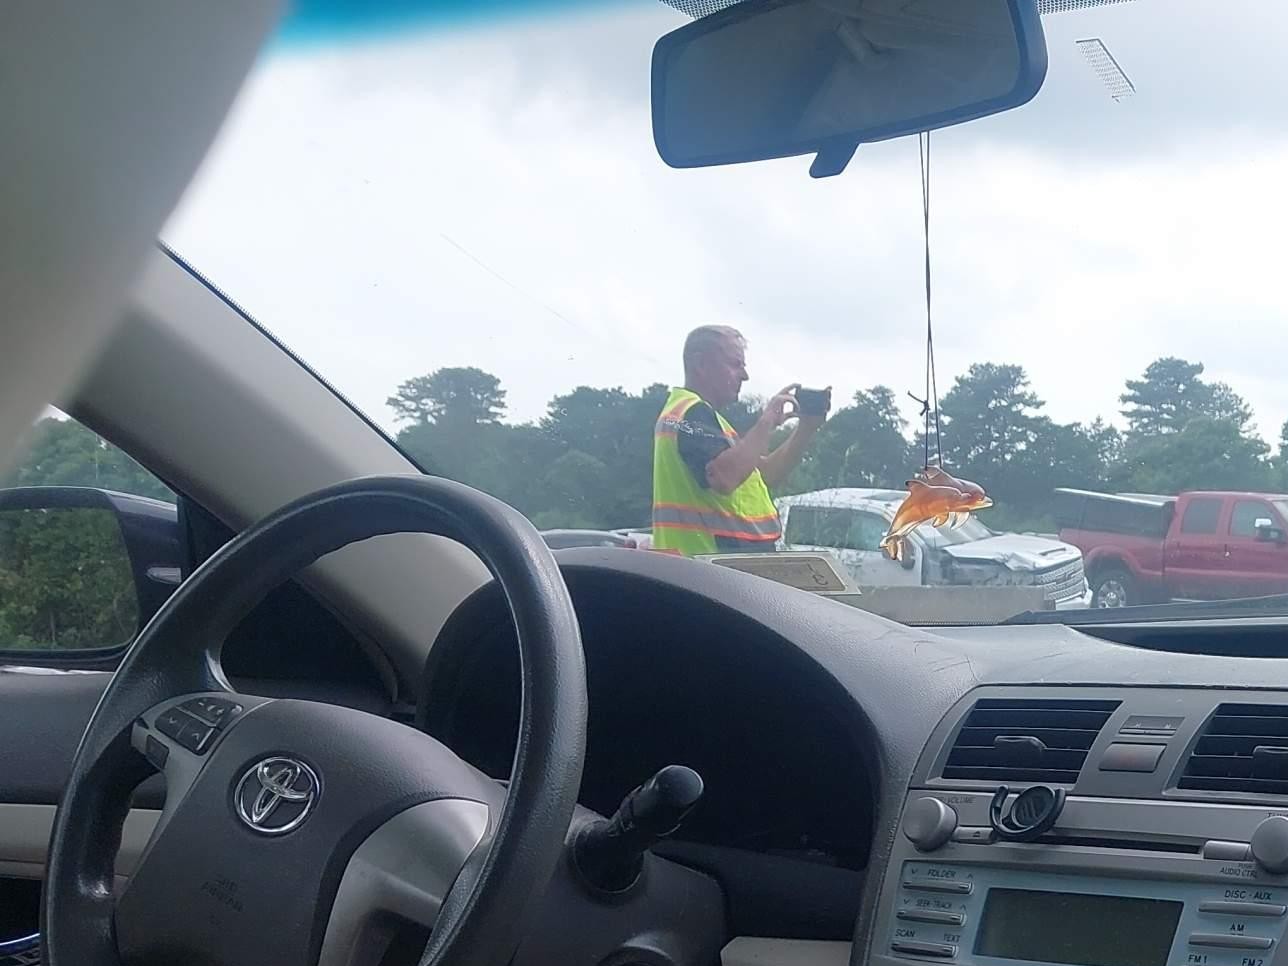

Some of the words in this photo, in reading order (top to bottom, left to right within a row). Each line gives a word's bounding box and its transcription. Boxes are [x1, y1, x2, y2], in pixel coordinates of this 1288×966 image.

[927, 868, 956, 878] FOLDER
[1220, 866, 1241, 876] AUDIO
[1224, 890, 1246, 899] DISC
[1254, 891, 1273, 900] AUX
[1230, 923, 1245, 932] AM
[895, 928, 915, 938] SCAN
